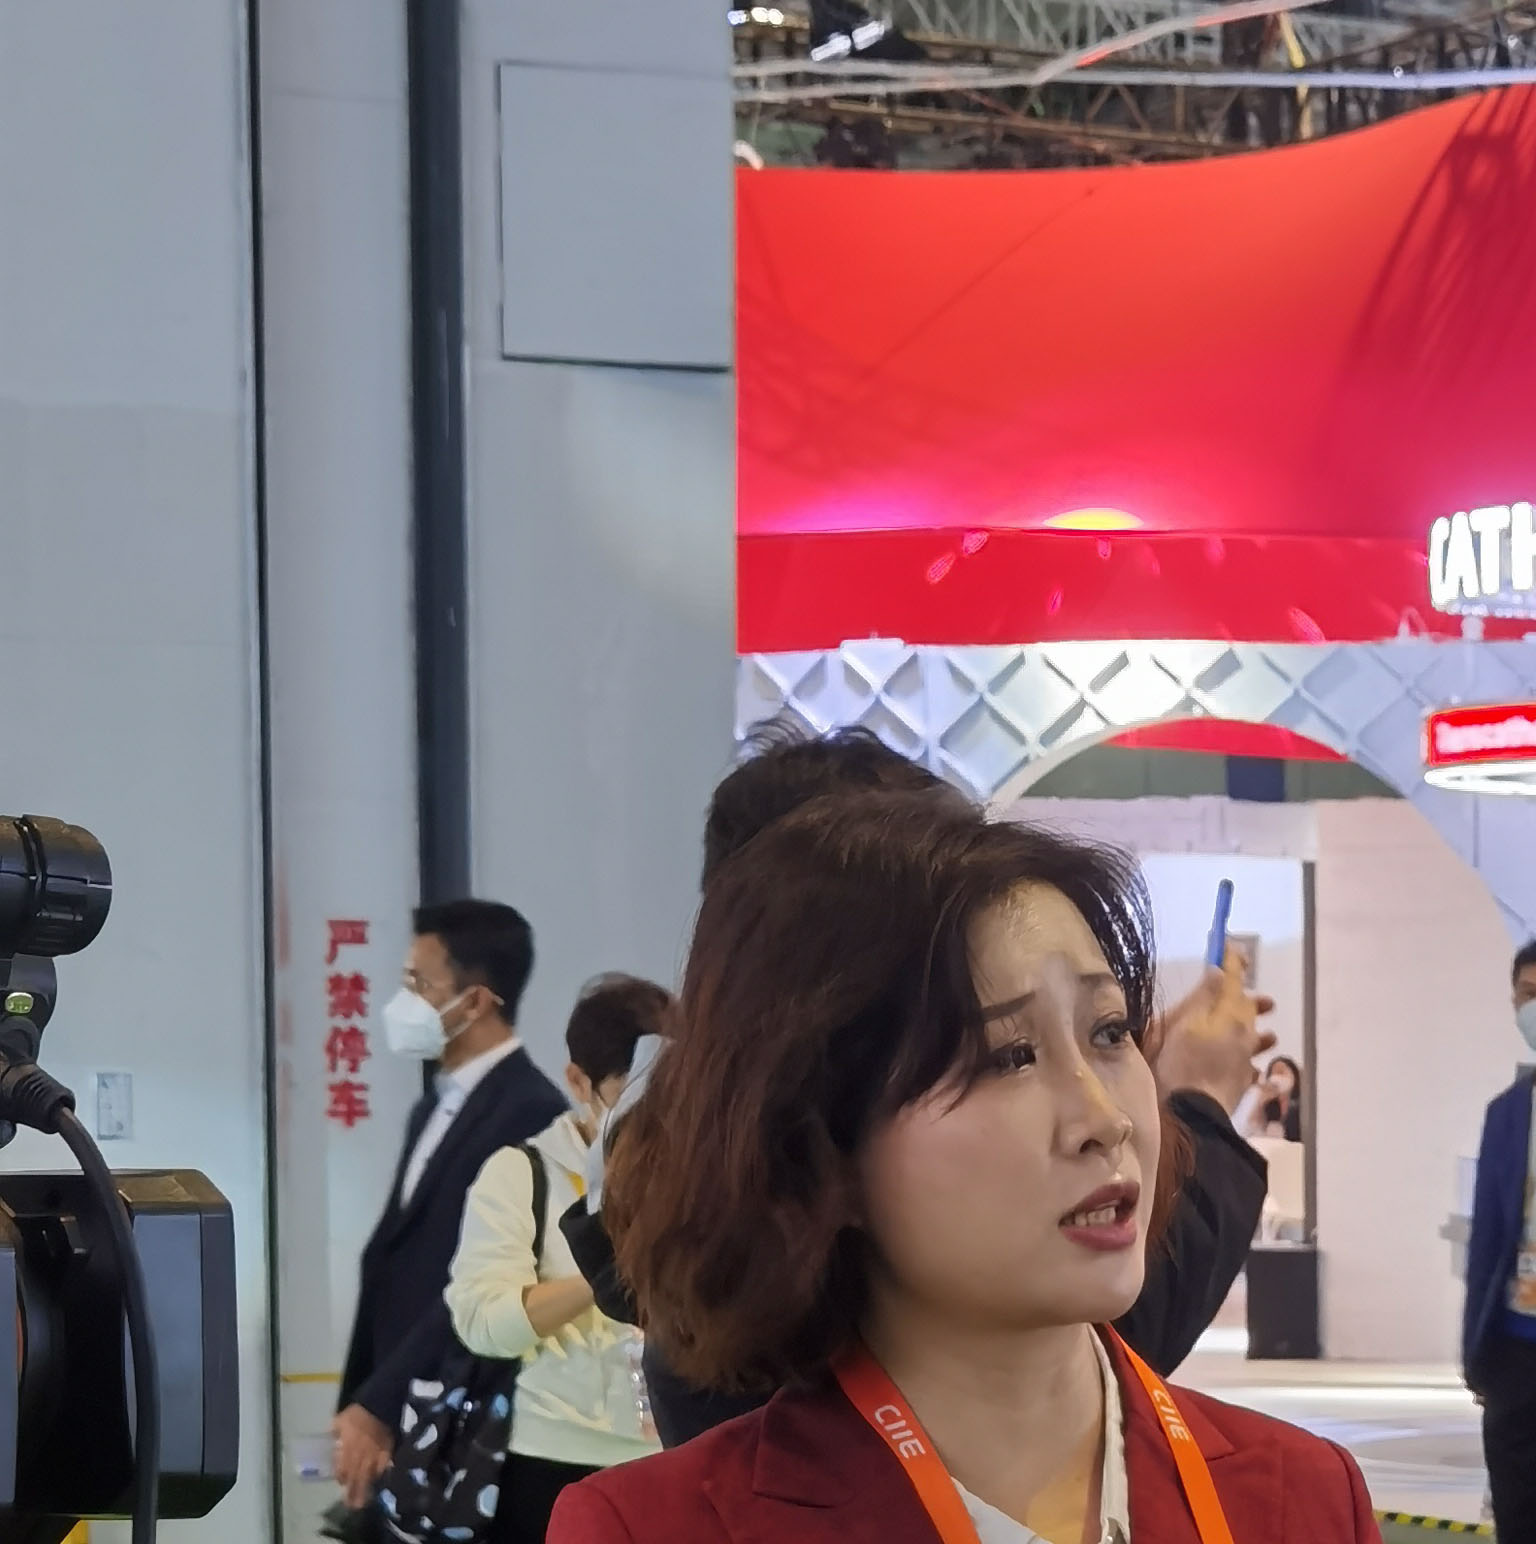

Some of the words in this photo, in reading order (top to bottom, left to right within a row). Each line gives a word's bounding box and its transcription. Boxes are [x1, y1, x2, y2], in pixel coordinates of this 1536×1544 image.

[325, 919, 372, 1130] 严禁停车
[874, 1404, 926, 1459] CIIE
[1153, 1389, 1190, 1441] CIIE
